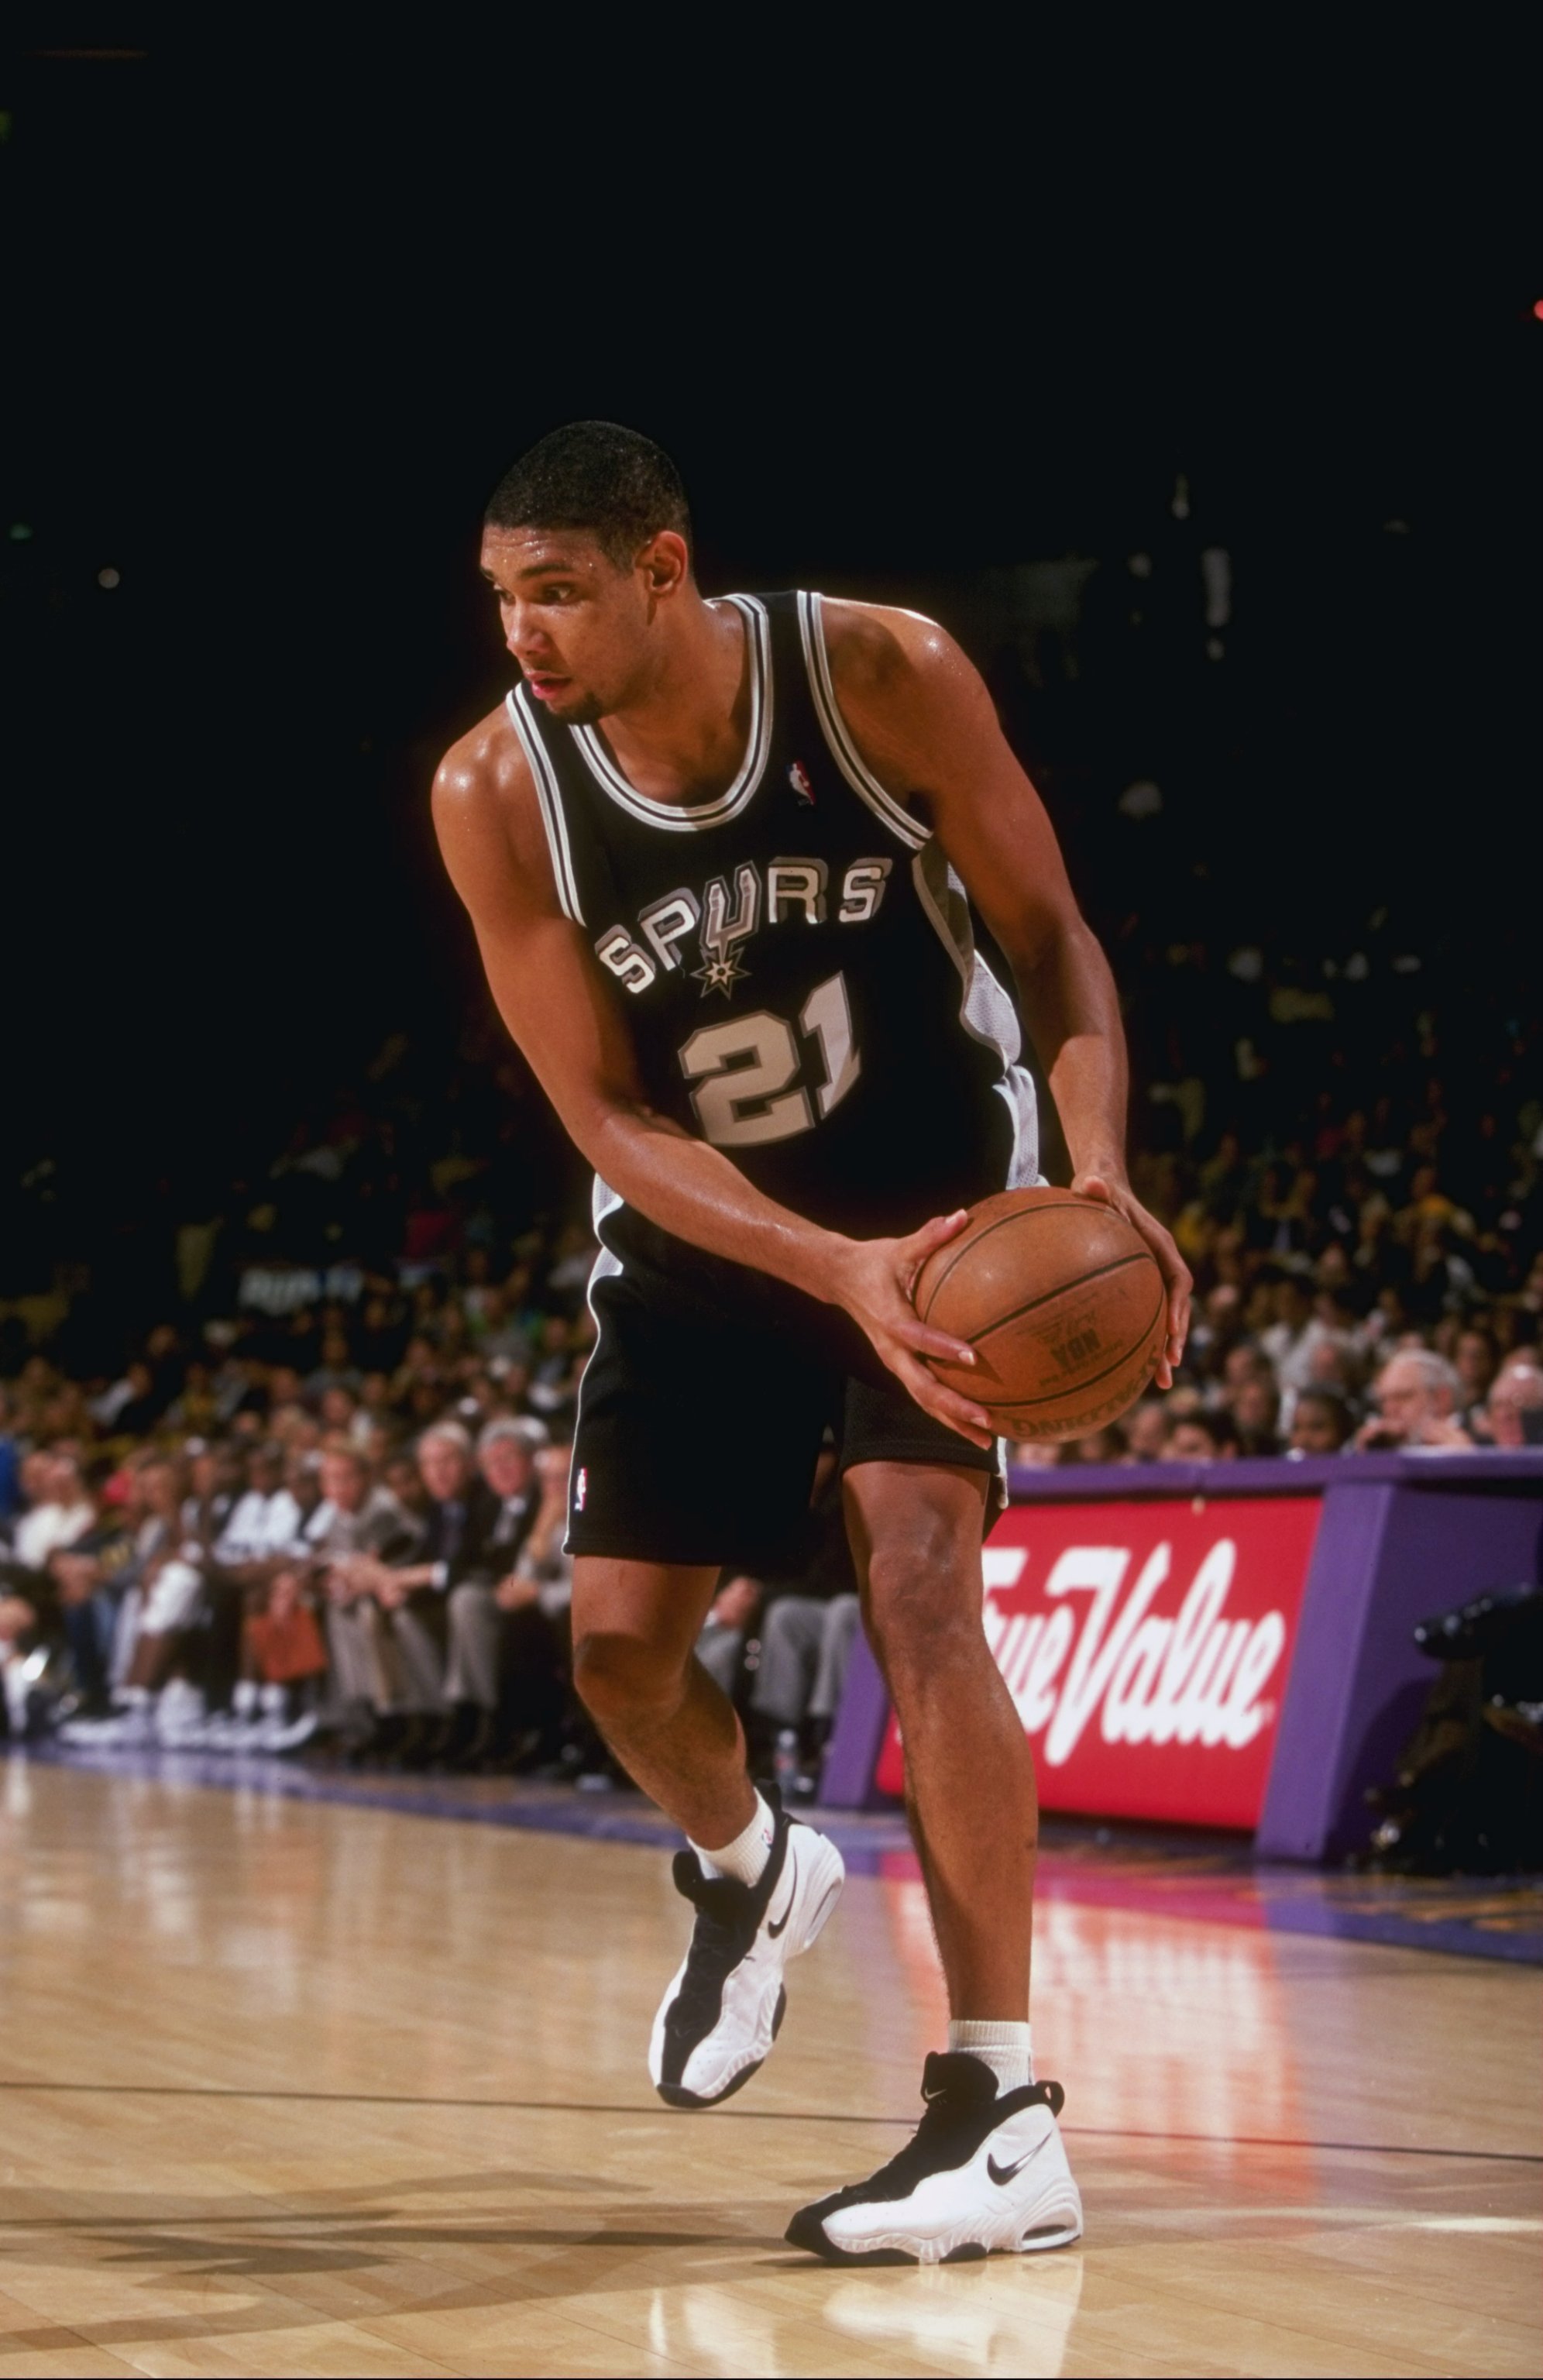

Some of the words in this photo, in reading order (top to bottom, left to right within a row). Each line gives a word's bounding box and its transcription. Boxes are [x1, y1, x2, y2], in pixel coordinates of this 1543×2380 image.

[594, 855, 893, 1000] SPURS
[678, 970, 862, 1147] 21
[1043, 1538, 1285, 1767] Value
